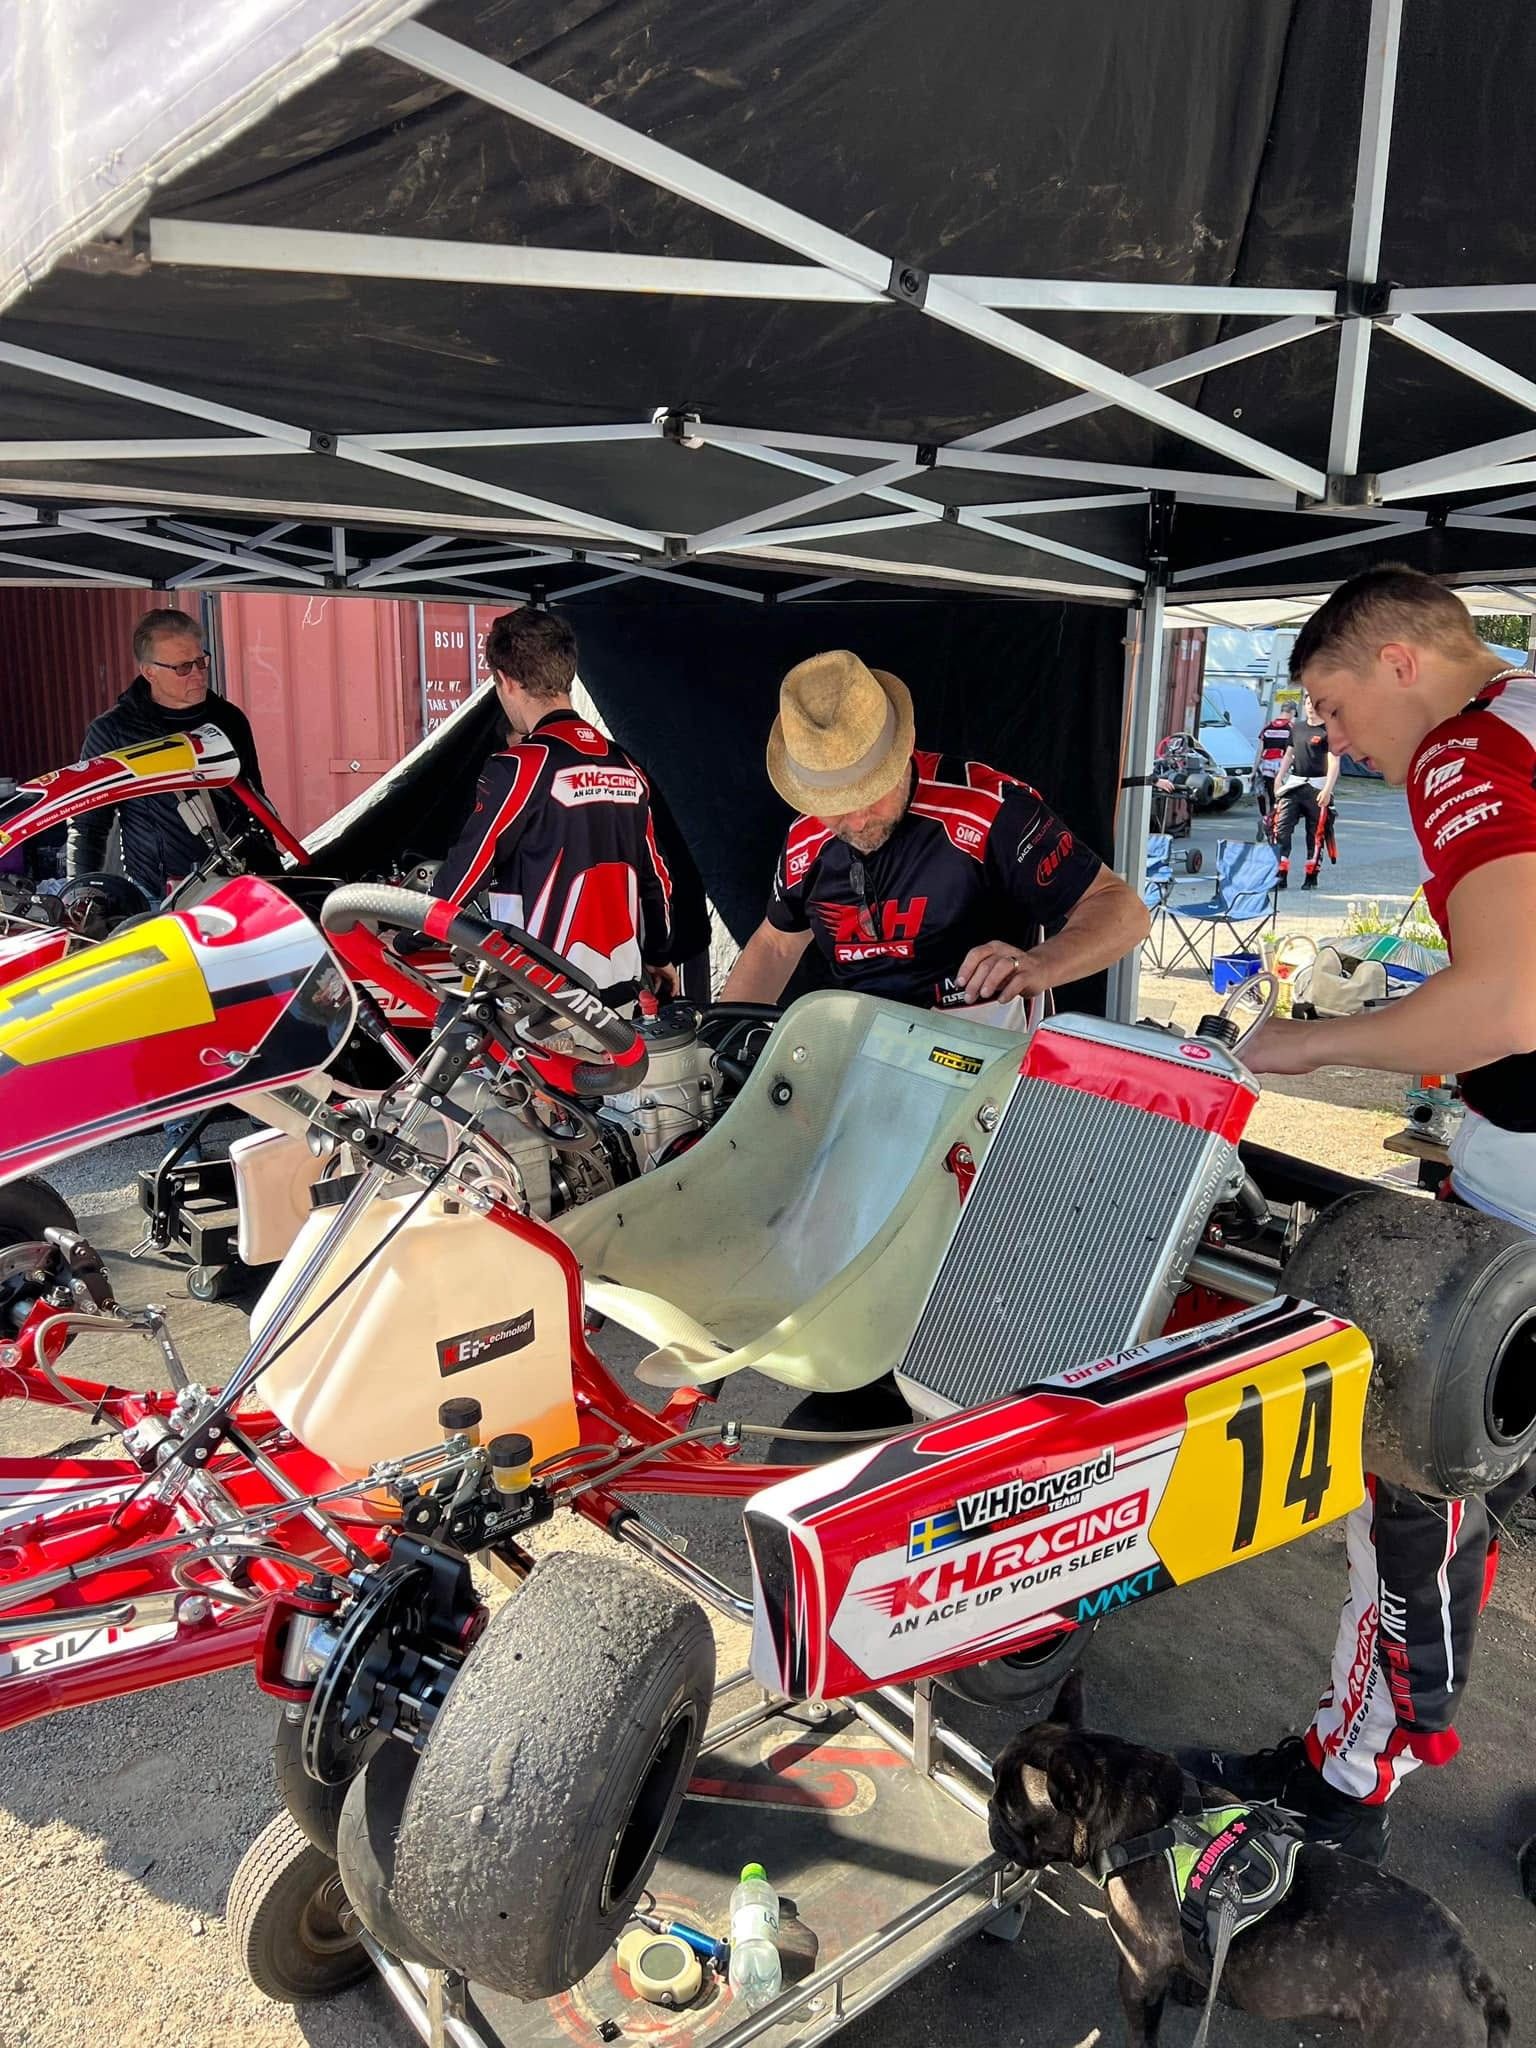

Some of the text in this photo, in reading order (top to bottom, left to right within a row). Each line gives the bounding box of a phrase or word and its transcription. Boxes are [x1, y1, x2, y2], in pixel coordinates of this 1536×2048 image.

[434, 631, 464, 648] BSIU
[428, 699, 448, 711] TARE
[1424, 780, 1494, 829] KRAFTWERK
[956, 826, 982, 845] OMP
[1017, 843, 1034, 863] RACE
[1062, 1344, 1151, 1385] birelART
[1226, 1361, 1334, 1553] 14
[1048, 1493, 1082, 1513] TEAM
[888, 1534, 1139, 1639] AN ACE UP YOUR SLEEVE
[1347, 1724, 1362, 1751] ACE
[1196, 1830, 1237, 1876] BONNIE
